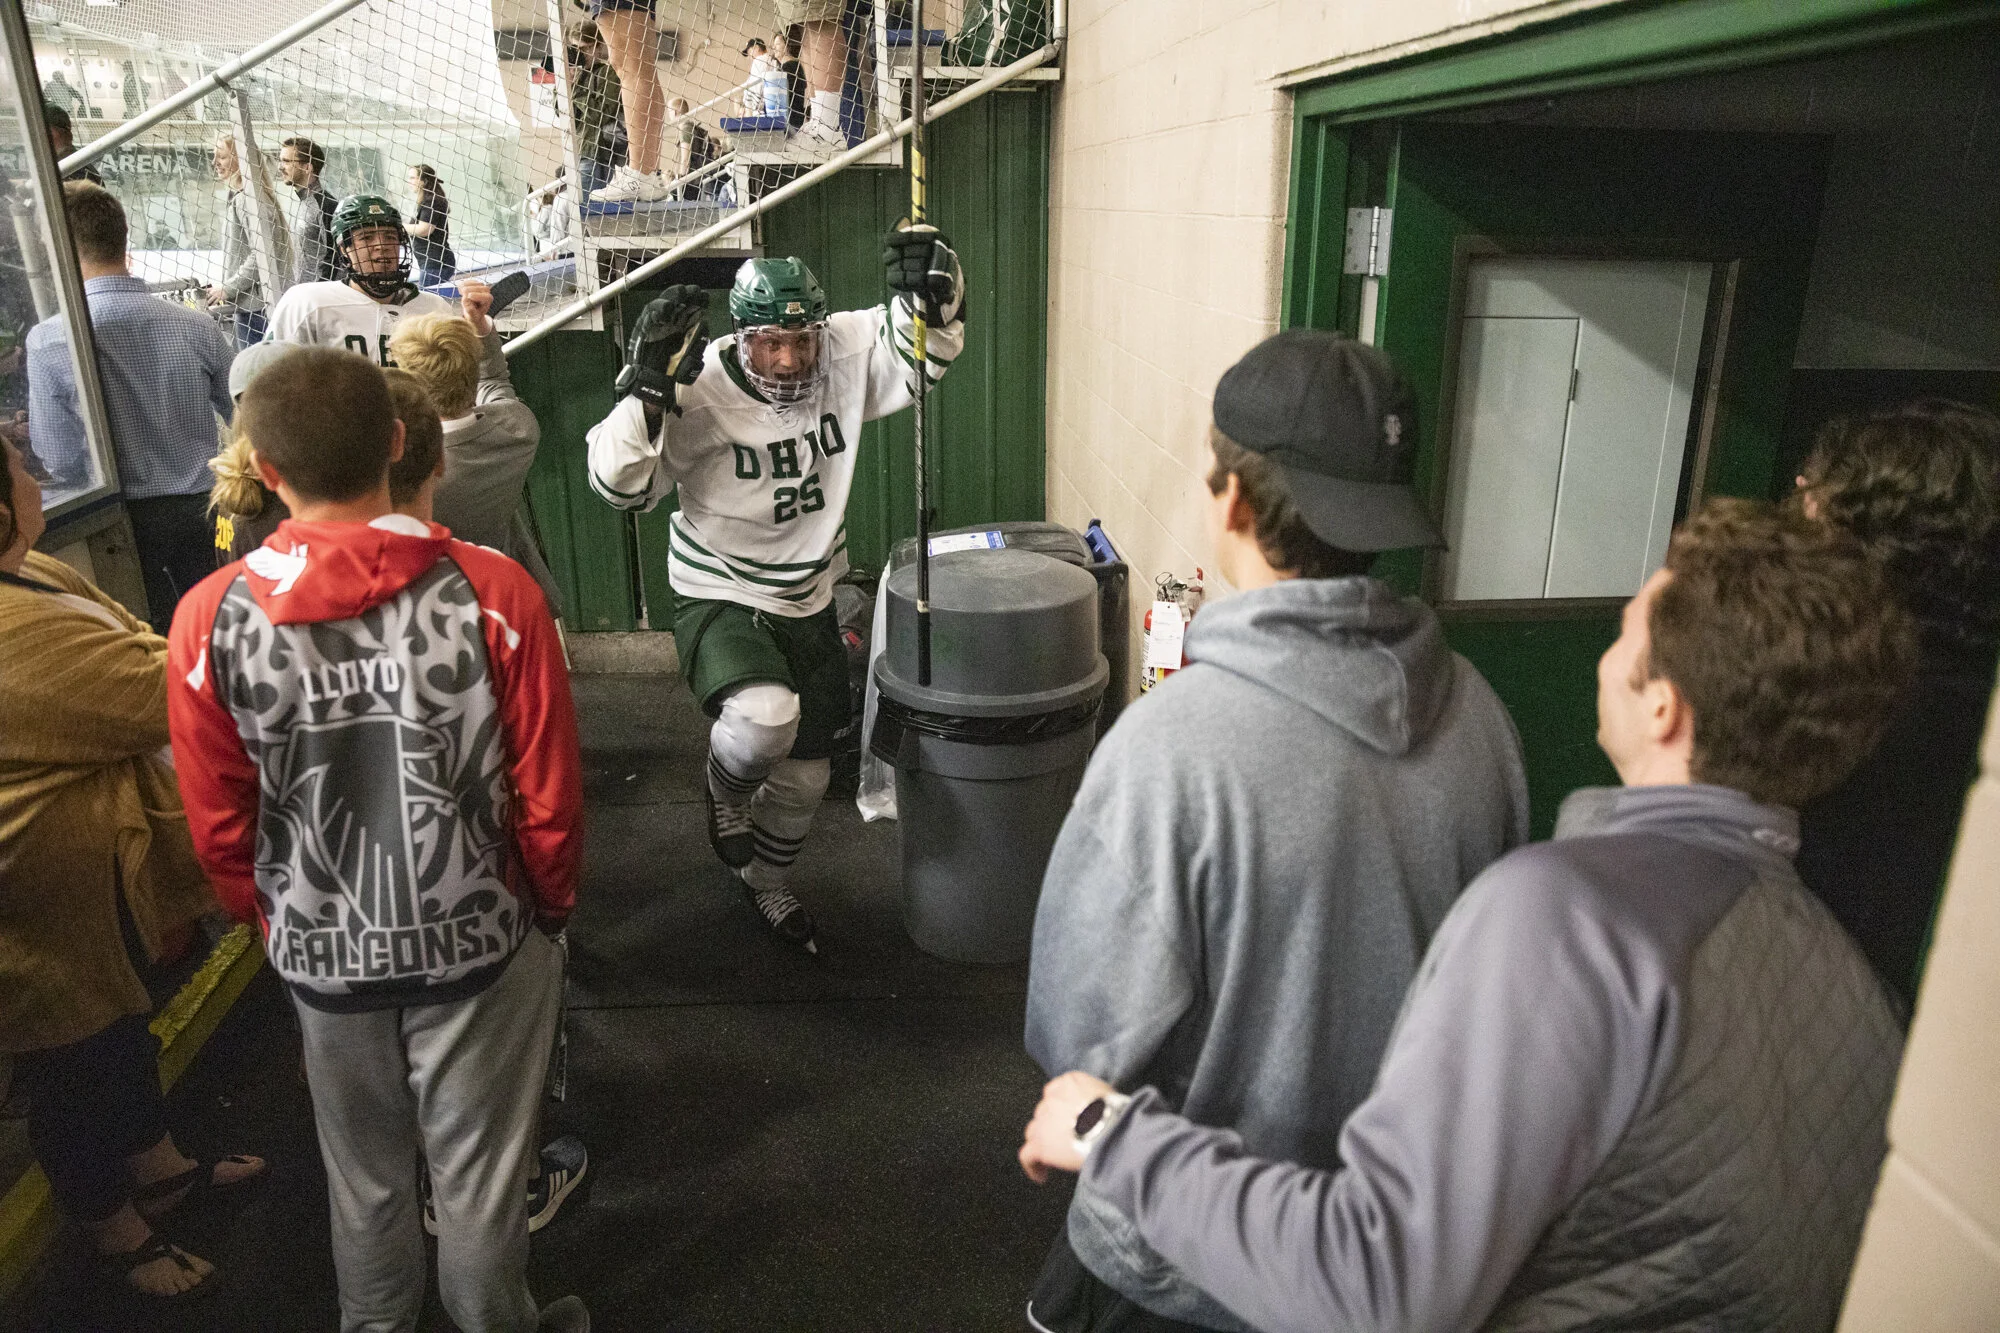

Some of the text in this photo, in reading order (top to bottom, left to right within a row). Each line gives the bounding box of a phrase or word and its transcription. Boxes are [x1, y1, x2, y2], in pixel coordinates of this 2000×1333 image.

[98, 153, 192, 173] ARENA
[732, 412, 847, 480] OHIO
[773, 472, 826, 524] 25
[301, 656, 400, 702] LLOYD
[286, 914, 484, 978] FALCONS
